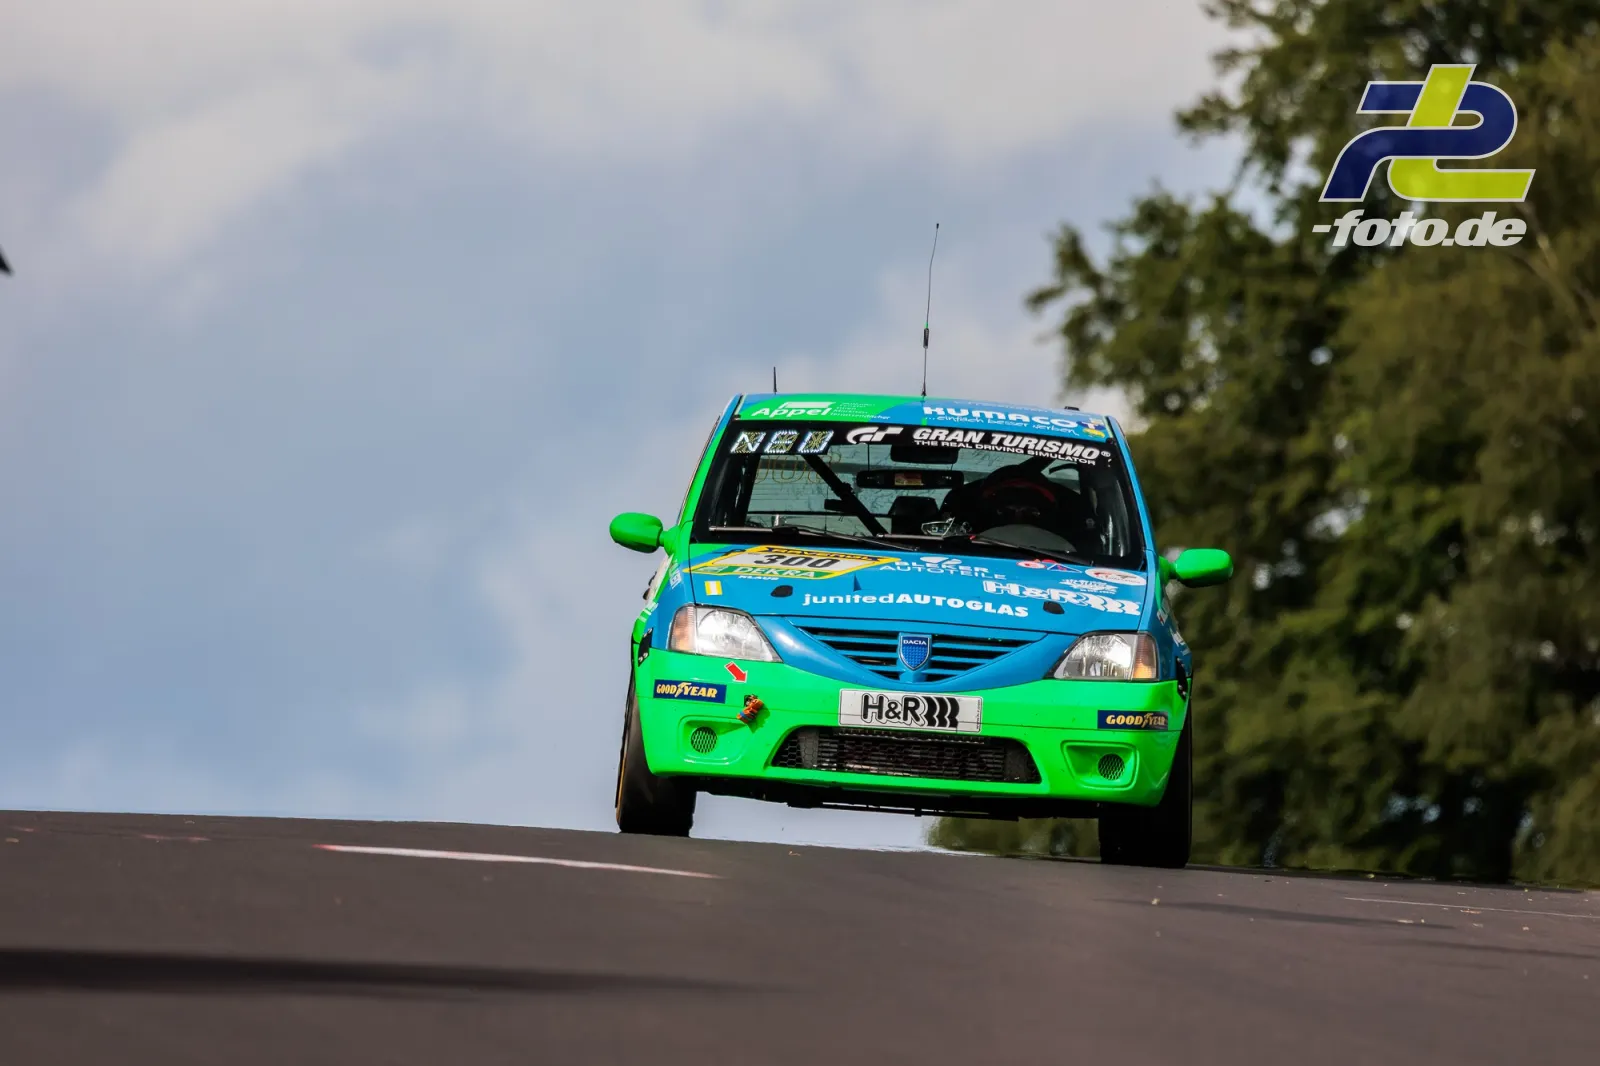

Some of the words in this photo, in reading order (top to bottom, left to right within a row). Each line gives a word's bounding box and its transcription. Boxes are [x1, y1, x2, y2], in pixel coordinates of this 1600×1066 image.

[751, 407, 832, 418] Appel
[913, 428, 985, 444] GRAN
[941, 441, 974, 449] REAL
[975, 443, 1024, 455] DRIVING
[1027, 450, 1097, 466] SIMULATOR
[755, 554, 840, 568] 300
[733, 566, 815, 578] DEKRA
[879, 565, 1007, 580] AUTOTEILE
[803, 592, 1029, 618] junitedAUTOGLAS
[656, 682, 718, 698] GOODYEAR
[862, 693, 925, 727] H&R
